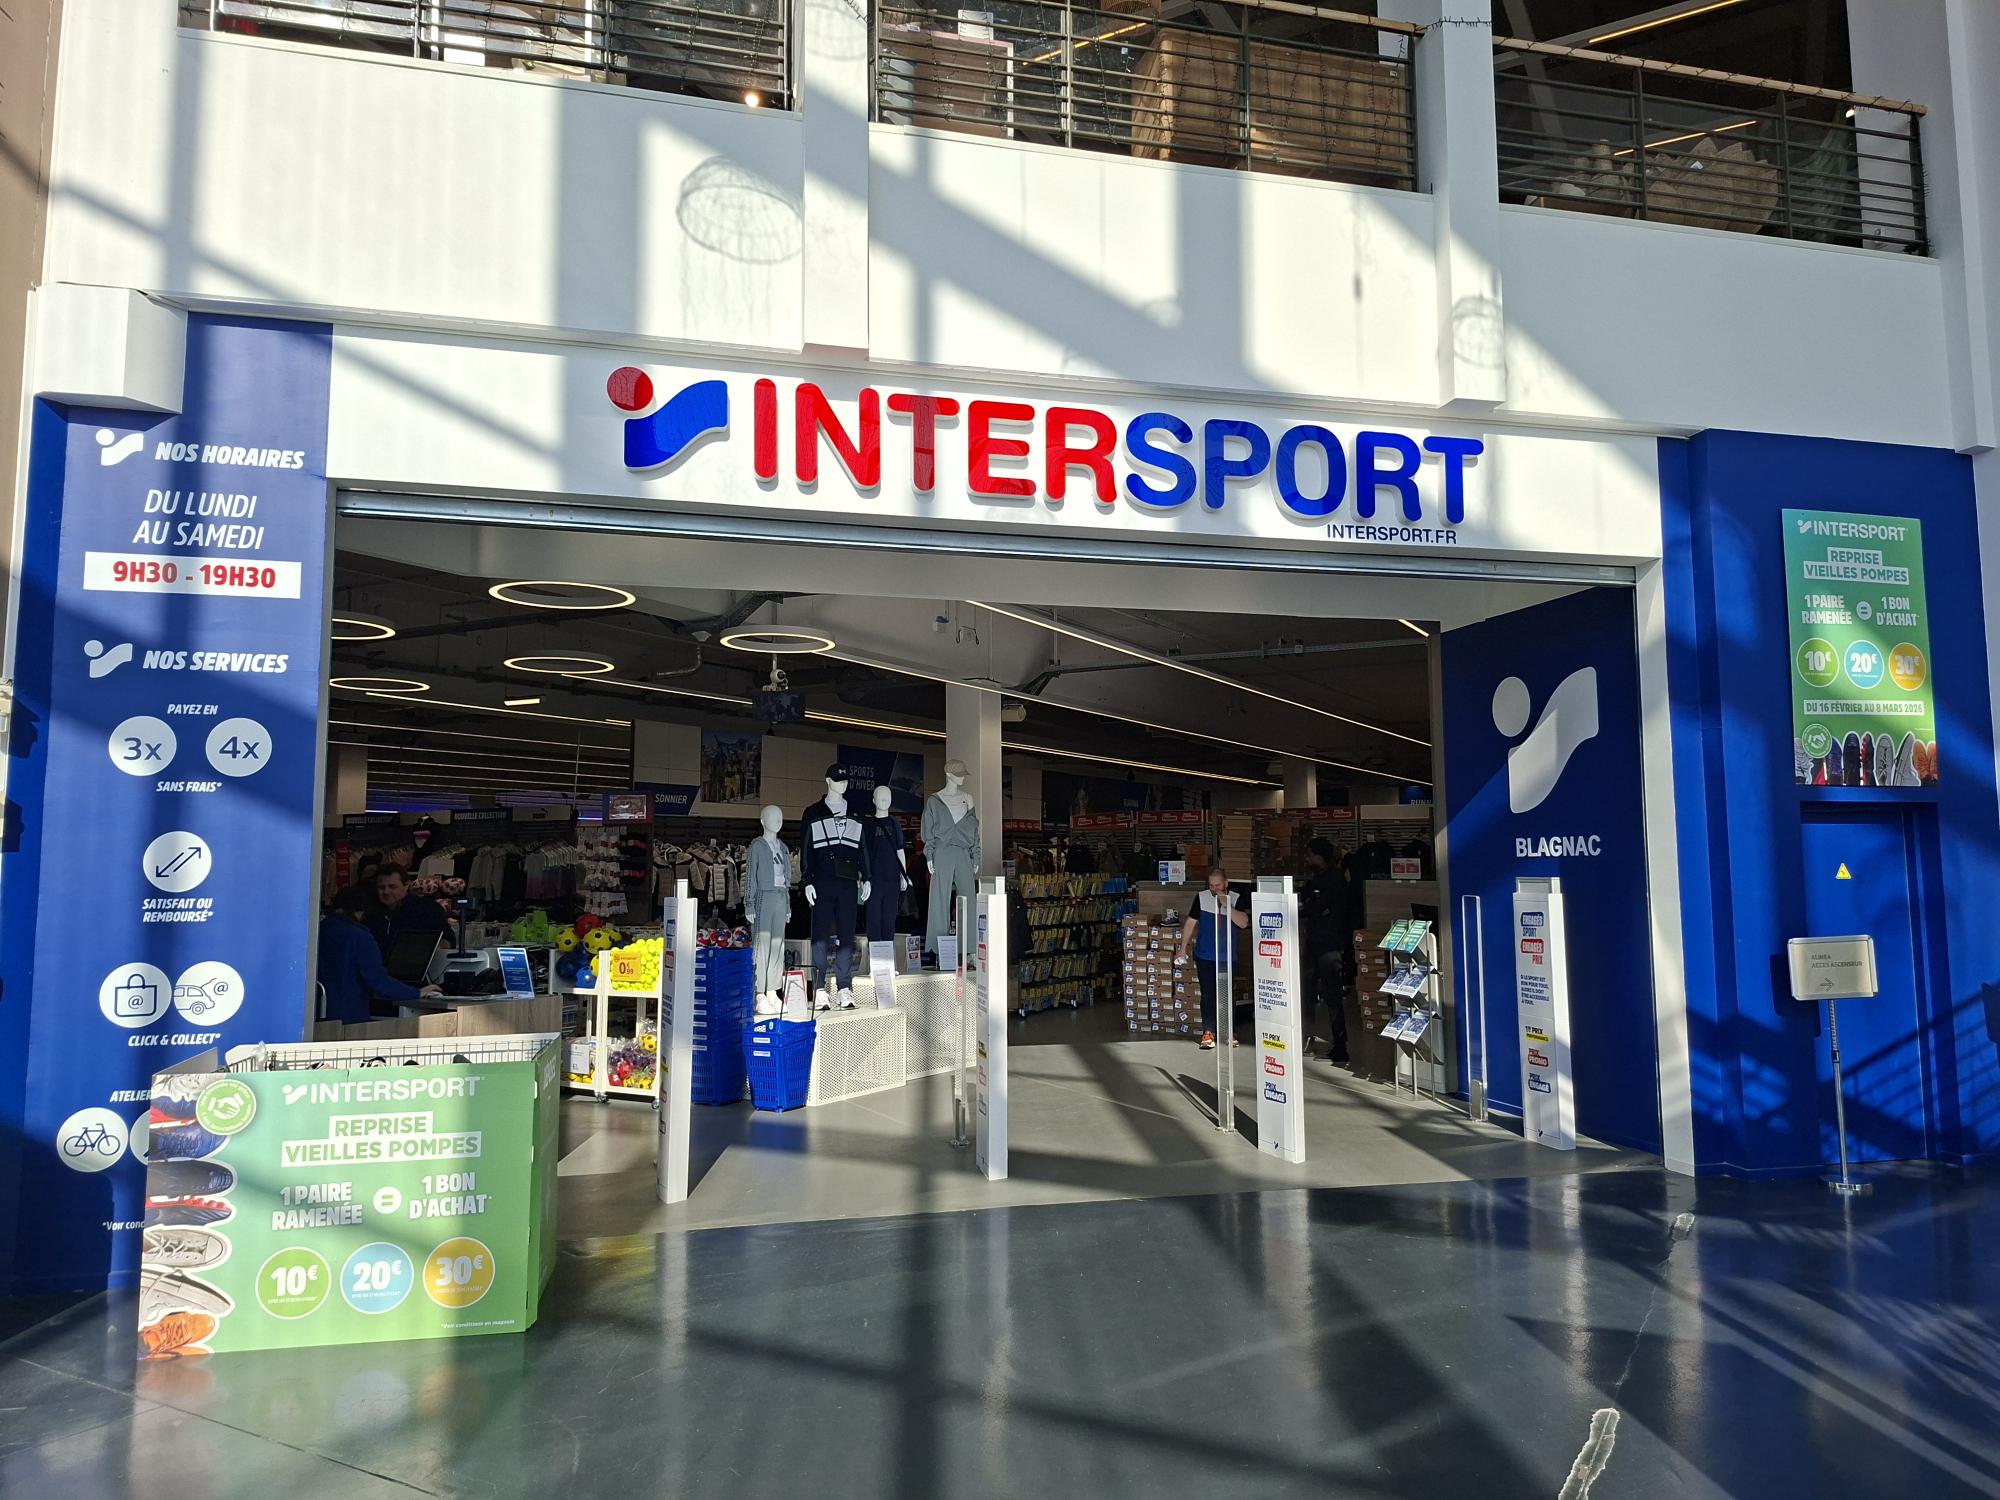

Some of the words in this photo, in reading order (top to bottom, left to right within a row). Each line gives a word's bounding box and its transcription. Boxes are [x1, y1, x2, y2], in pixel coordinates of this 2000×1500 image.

[155, 442, 198, 463] NOS
[200, 444, 305, 469] HORAIRES
[754, 378, 1484, 524] INTERSPORT
[143, 489, 179, 515] DU
[184, 492, 257, 519] LUNDI
[132, 520, 171, 545] AU
[173, 523, 265, 550] SAMEDI
[1325, 523, 1458, 545] INTERSPORT.FR
[1813, 520, 1907, 541] INTERSPORT
[1830, 550, 1880, 565] REPRISE
[112, 561, 178, 583] 9H30
[199, 564, 276, 589] 19H30
[1804, 564, 1858, 579] VIEILLES
[1860, 569, 1908, 584] POMPES
[1804, 595, 1810, 608] 1
[1812, 594, 1845, 609] PAIRE
[1881, 597, 1887, 609] 1
[1889, 597, 1910, 610] BON
[1801, 609, 1853, 625] RAMENÉE
[142, 650, 188, 670] NOS
[190, 652, 289, 674] SERVICES
[1804, 651, 1832, 672] 10€
[1851, 653, 1878, 673] 20€
[167, 703, 202, 715] PAYEZ
[203, 704, 218, 715] EN
[1806, 703, 1817, 712] DU
[1820, 703, 1830, 712] 16
[1831, 701, 1863, 713] FÉVRIER
[1864, 703, 1876, 712] AU
[1877, 704, 1881, 712] 8
[1882, 703, 1903, 713] MARS
[122, 737, 162, 761] 3x
[218, 736, 260, 760] 4x
[849, 764, 874, 778] SPORTS
[156, 780, 184, 792] SANS
[849, 778, 876, 791] D'HIVER
[655, 793, 688, 805] SONNIER
[1515, 834, 1601, 857] BLAGNAC
[142, 898, 194, 910] SATISFAIT
[195, 898, 213, 909] OU
[1260, 928, 1276, 939] SPORT
[1522, 927, 1537, 938] SPORT
[1270, 957, 1282, 968] PRIX
[127, 1034, 159, 1047] CLICK
[160, 1034, 169, 1045] &
[1269, 1033, 1281, 1042] PRIX
[310, 1075, 481, 1104] INTERSPORT
[1265, 1082, 1277, 1091] PRIX
[334, 1115, 427, 1137] REPRISE
[285, 1140, 383, 1163] VIEILLES
[388, 1135, 479, 1159] POMPES
[280, 1186, 290, 1206] 1
[295, 1181, 353, 1206] PAIRE
[421, 1174, 432, 1194] 1
[438, 1172, 476, 1195] BON
[271, 1203, 364, 1231] RAMENÉE
[270, 1264, 319, 1297] 10€
[352, 1260, 403, 1292] 20€
[434, 1254, 485, 1286] 30€
